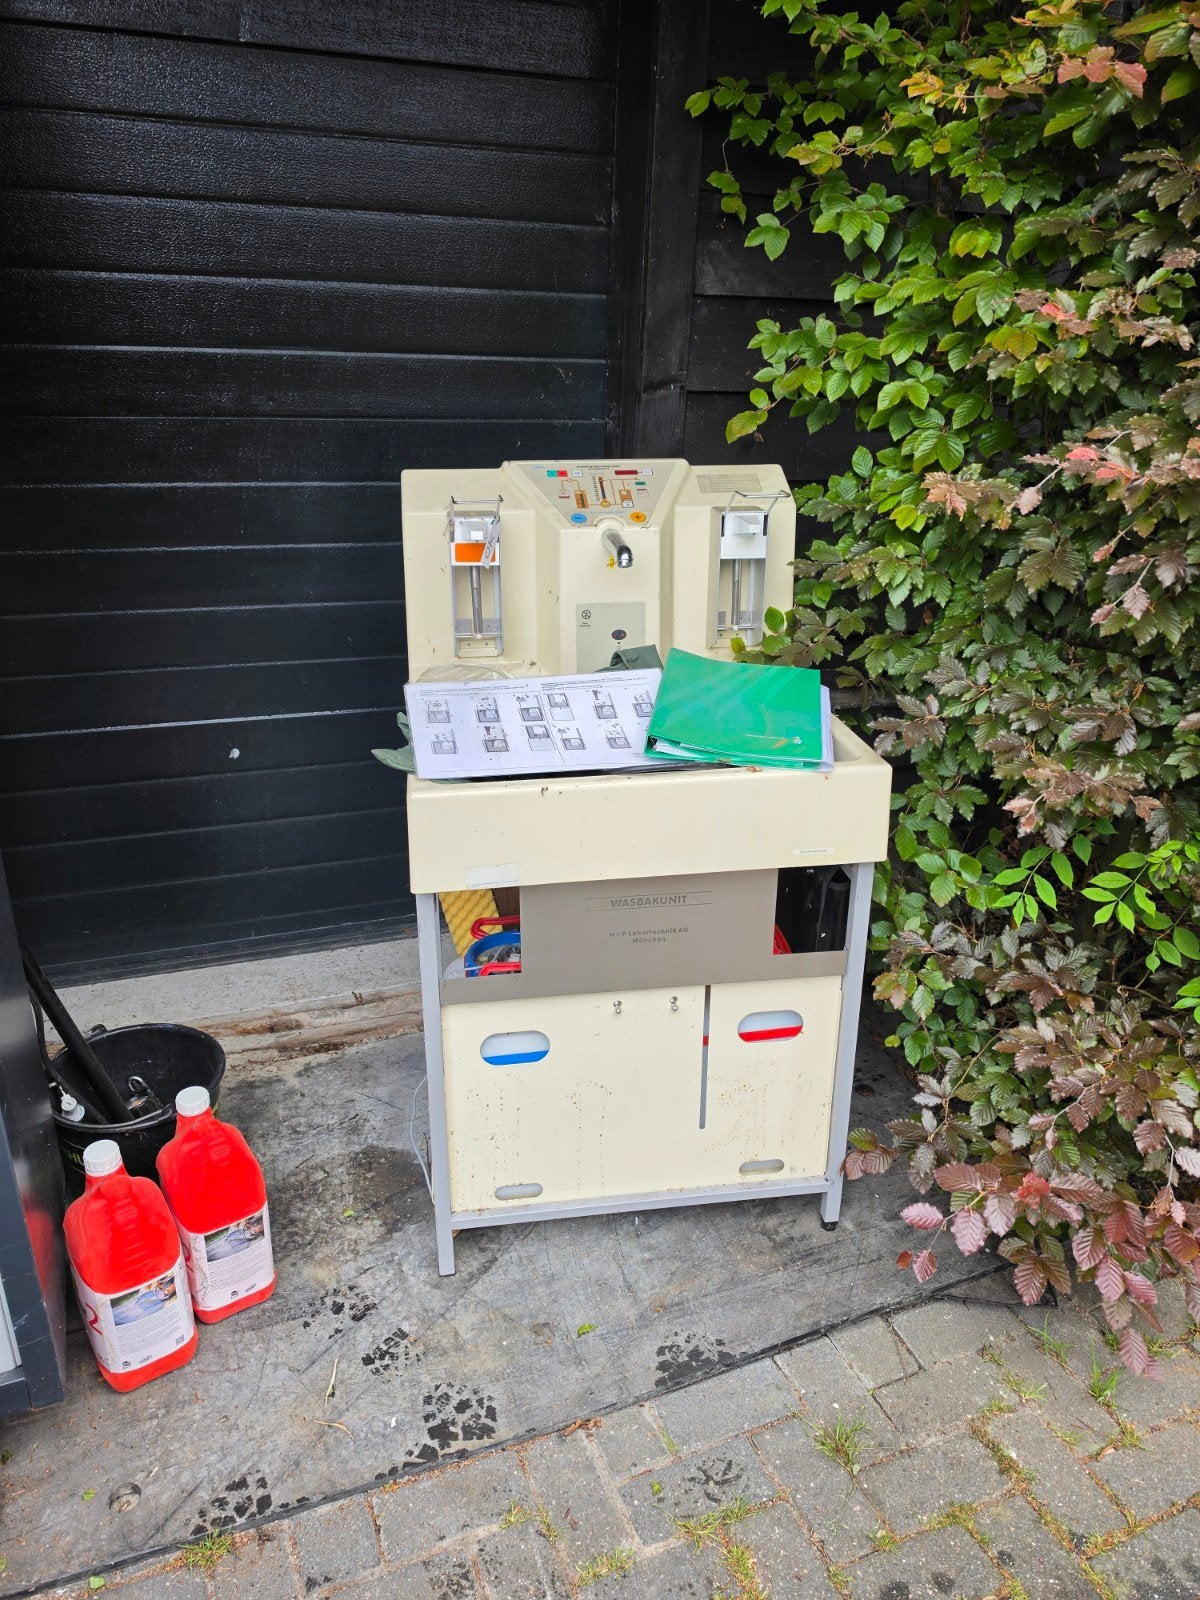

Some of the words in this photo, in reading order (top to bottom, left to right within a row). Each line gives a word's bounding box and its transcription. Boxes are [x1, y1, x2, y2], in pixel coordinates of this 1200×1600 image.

[610, 895, 688, 908] WASBAKUNIT
[628, 927, 677, 937] Labortechnik
[677, 926, 689, 935] AG
[85, 1302, 103, 1335] 2
